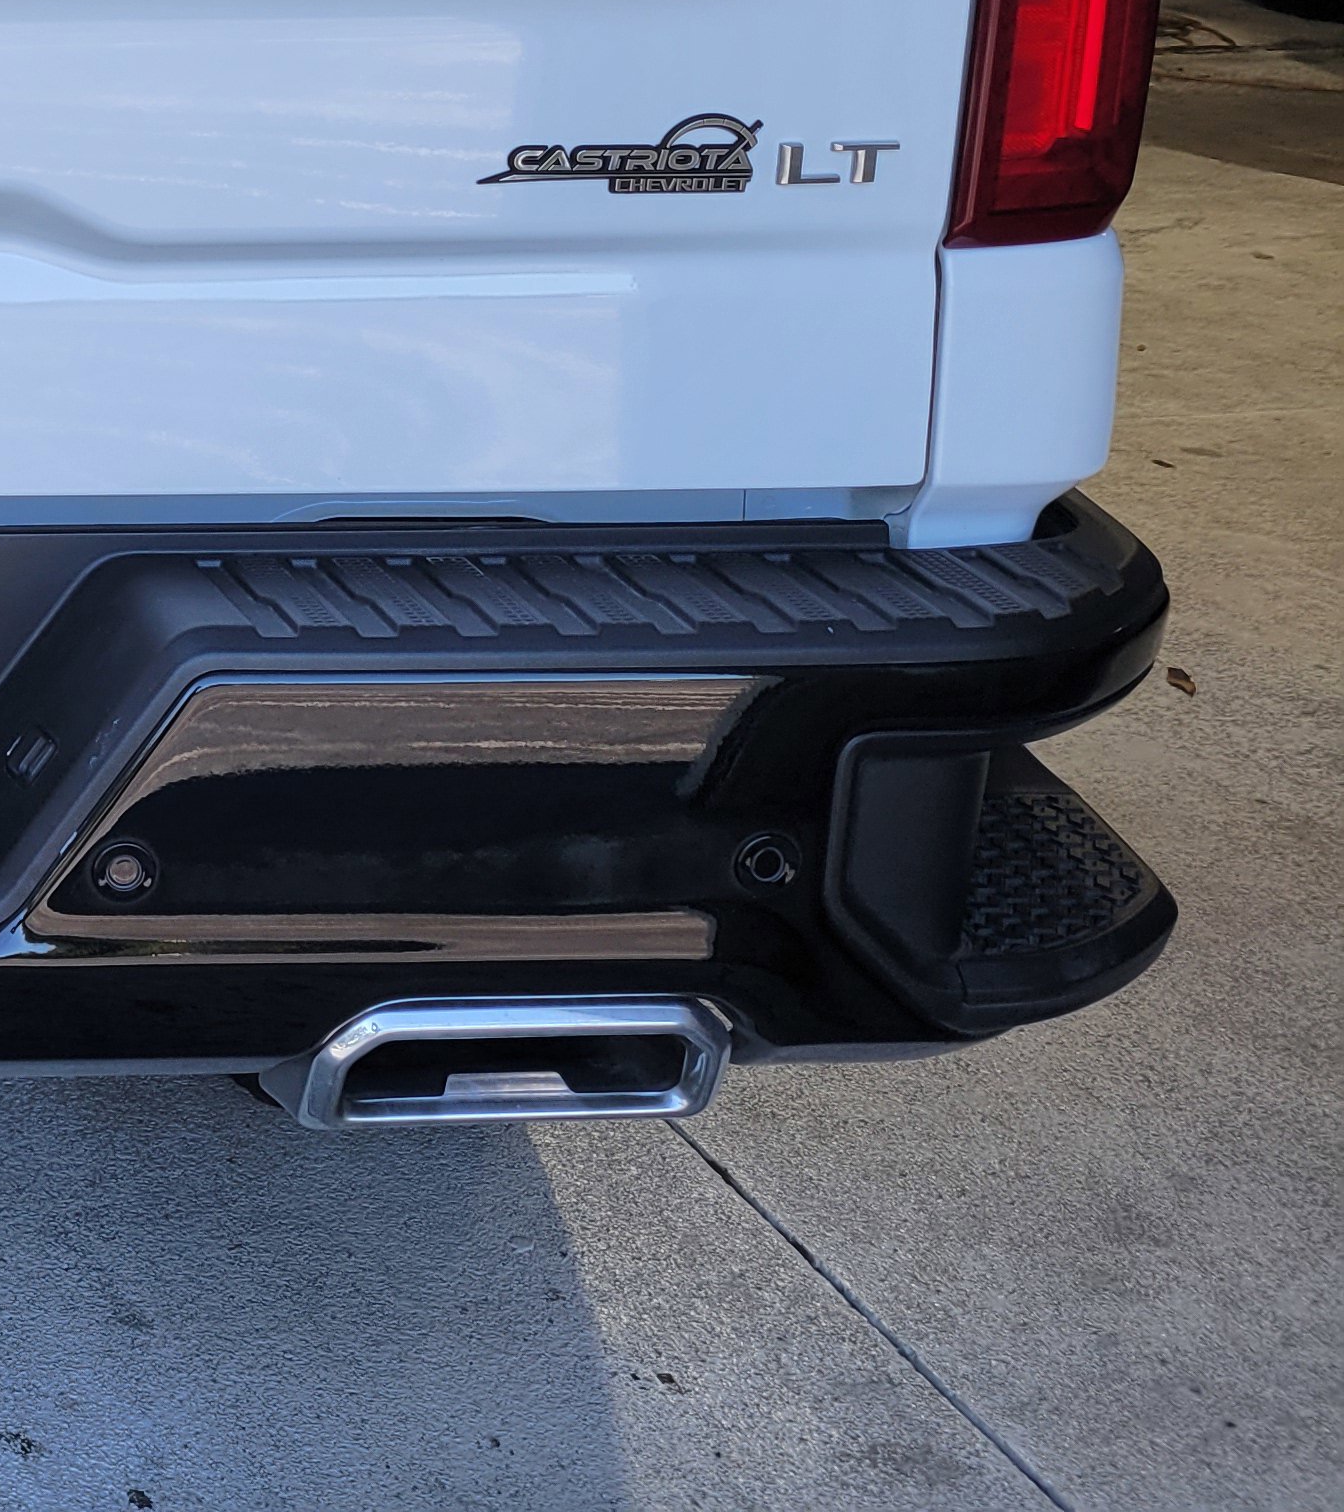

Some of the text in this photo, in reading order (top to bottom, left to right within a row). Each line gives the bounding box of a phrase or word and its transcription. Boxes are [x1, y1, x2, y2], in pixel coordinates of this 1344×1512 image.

[512, 144, 754, 172] CASTRIOTA
[776, 140, 900, 185] LT
[614, 177, 748, 192] CHEVROLET
